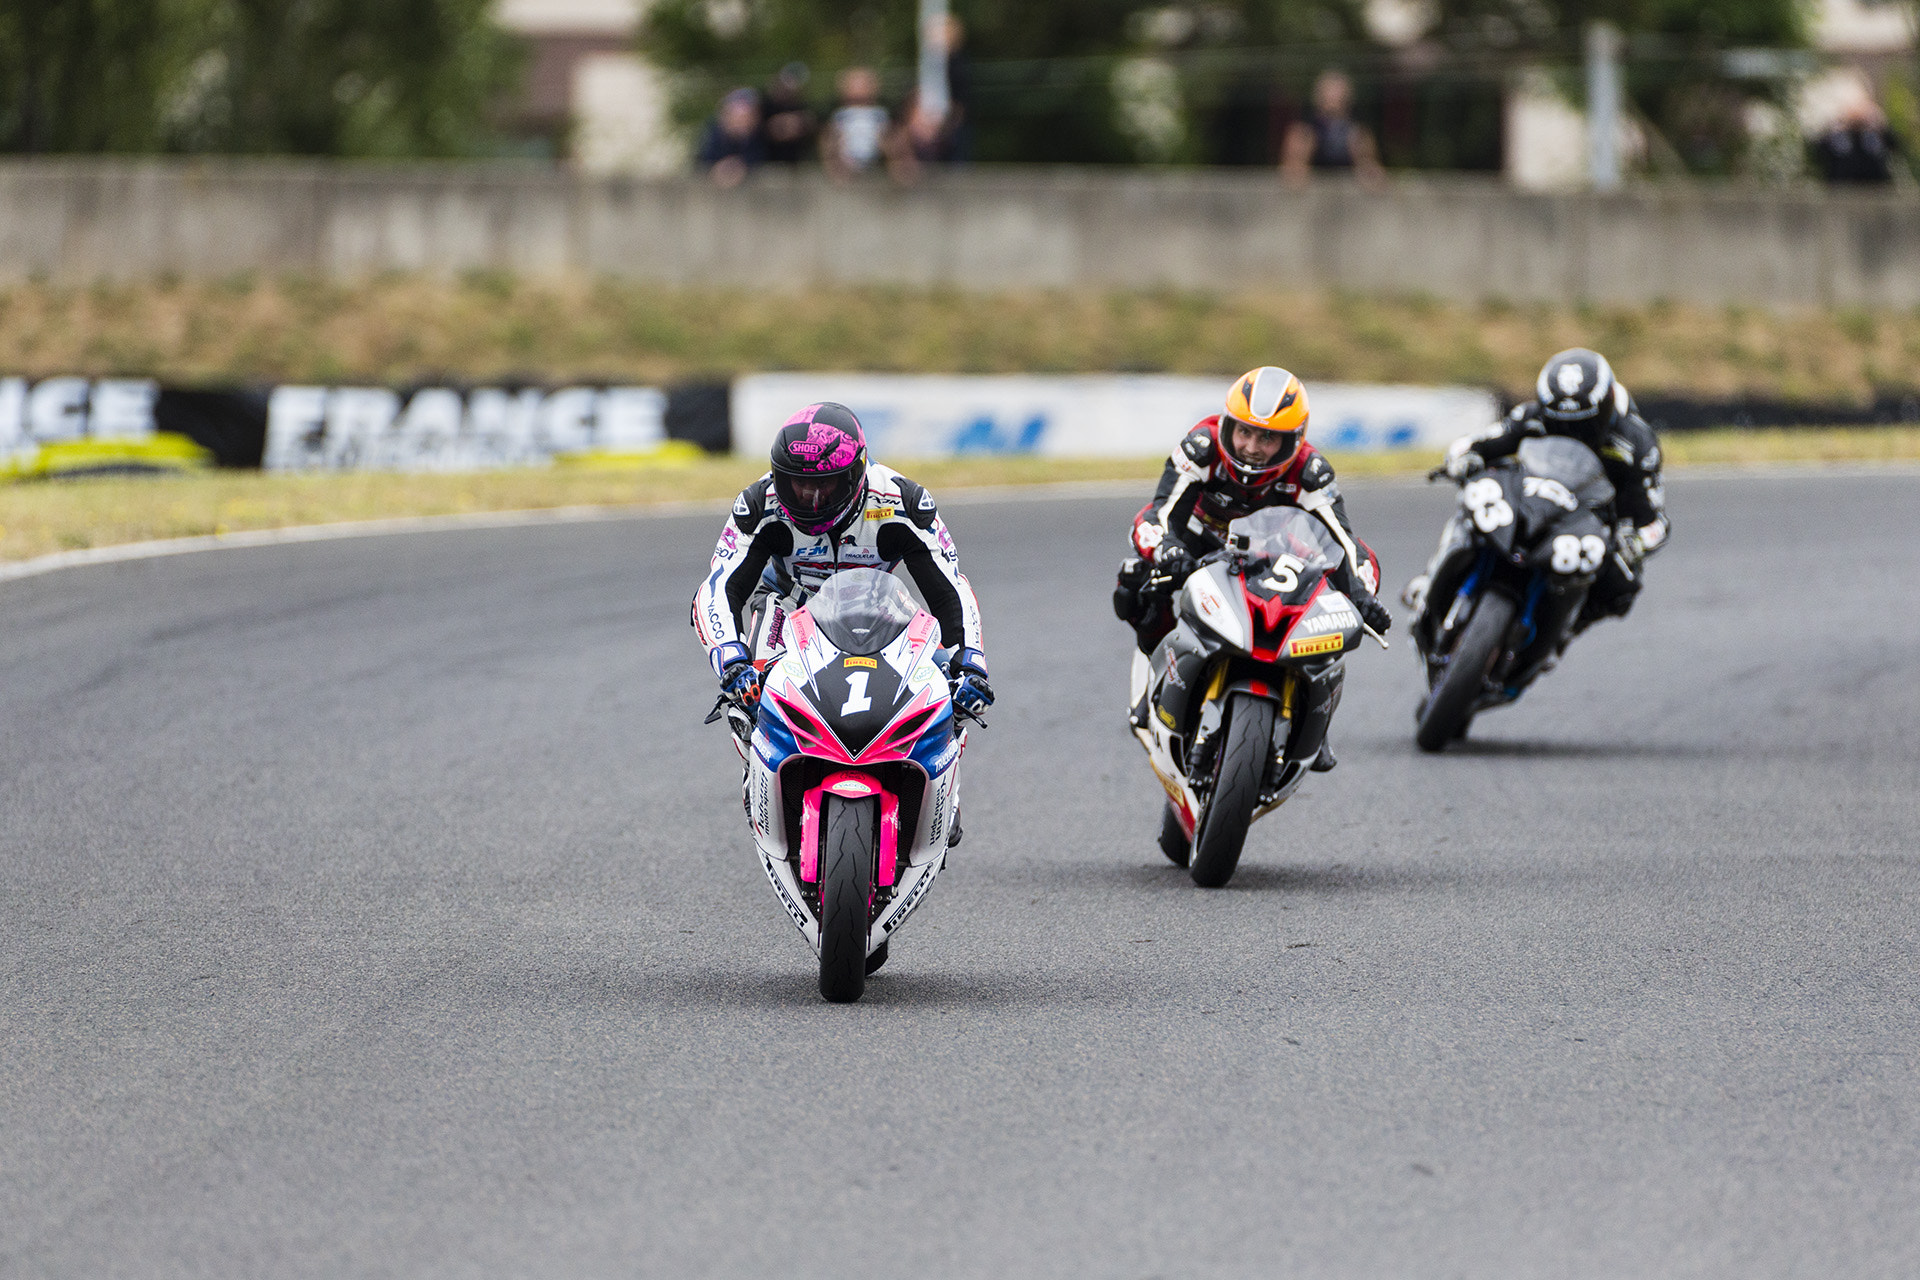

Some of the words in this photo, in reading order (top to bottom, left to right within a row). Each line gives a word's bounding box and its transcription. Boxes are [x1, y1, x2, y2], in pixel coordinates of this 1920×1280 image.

[265, 385, 668, 452] FRANCE
[792, 443, 819, 454] SHOEI
[866, 508, 892, 520] PIRELLI
[1552, 534, 1606, 574] 83
[1261, 553, 1305, 593] 5
[707, 599, 725, 640] YACCO
[1301, 611, 1359, 634] YAMAHA
[1291, 634, 1342, 655] PIRELLI
[845, 658, 876, 667] PIRELLI
[840, 671, 872, 717] 1
[929, 817, 938, 846] sport
